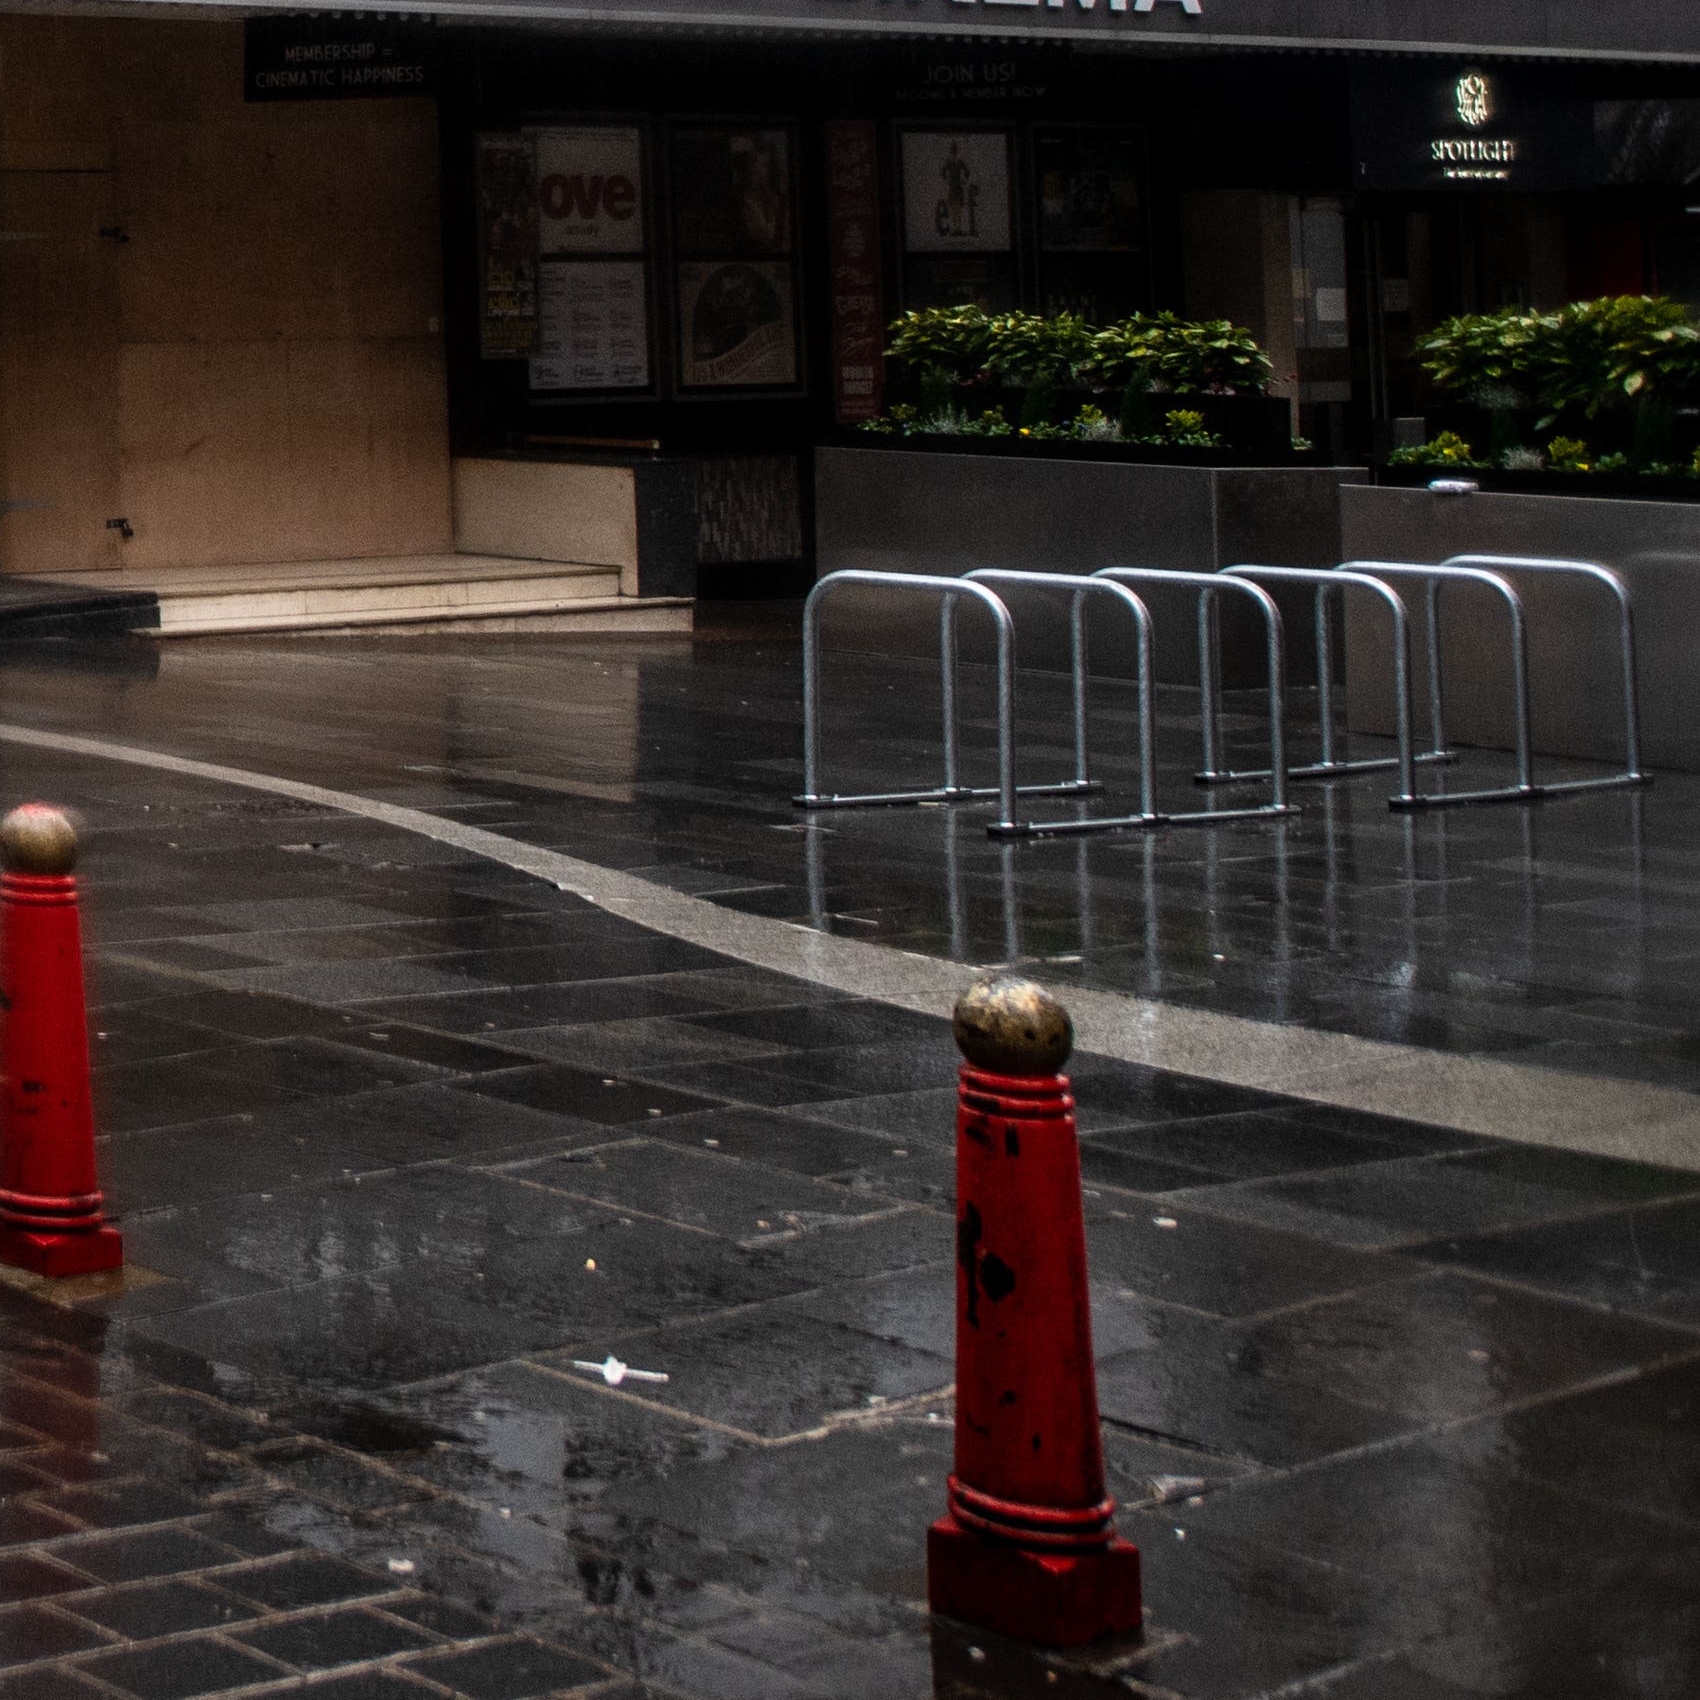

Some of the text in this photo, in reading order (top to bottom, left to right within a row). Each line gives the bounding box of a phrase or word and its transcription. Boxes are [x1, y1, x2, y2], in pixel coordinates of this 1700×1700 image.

[284, 43, 376, 62] MEMBERSHIP
[255, 65, 424, 88] CINEMATIC HAPPINESS
[920, 61, 1017, 85] JOIN US!
[540, 173, 636, 220] ove
